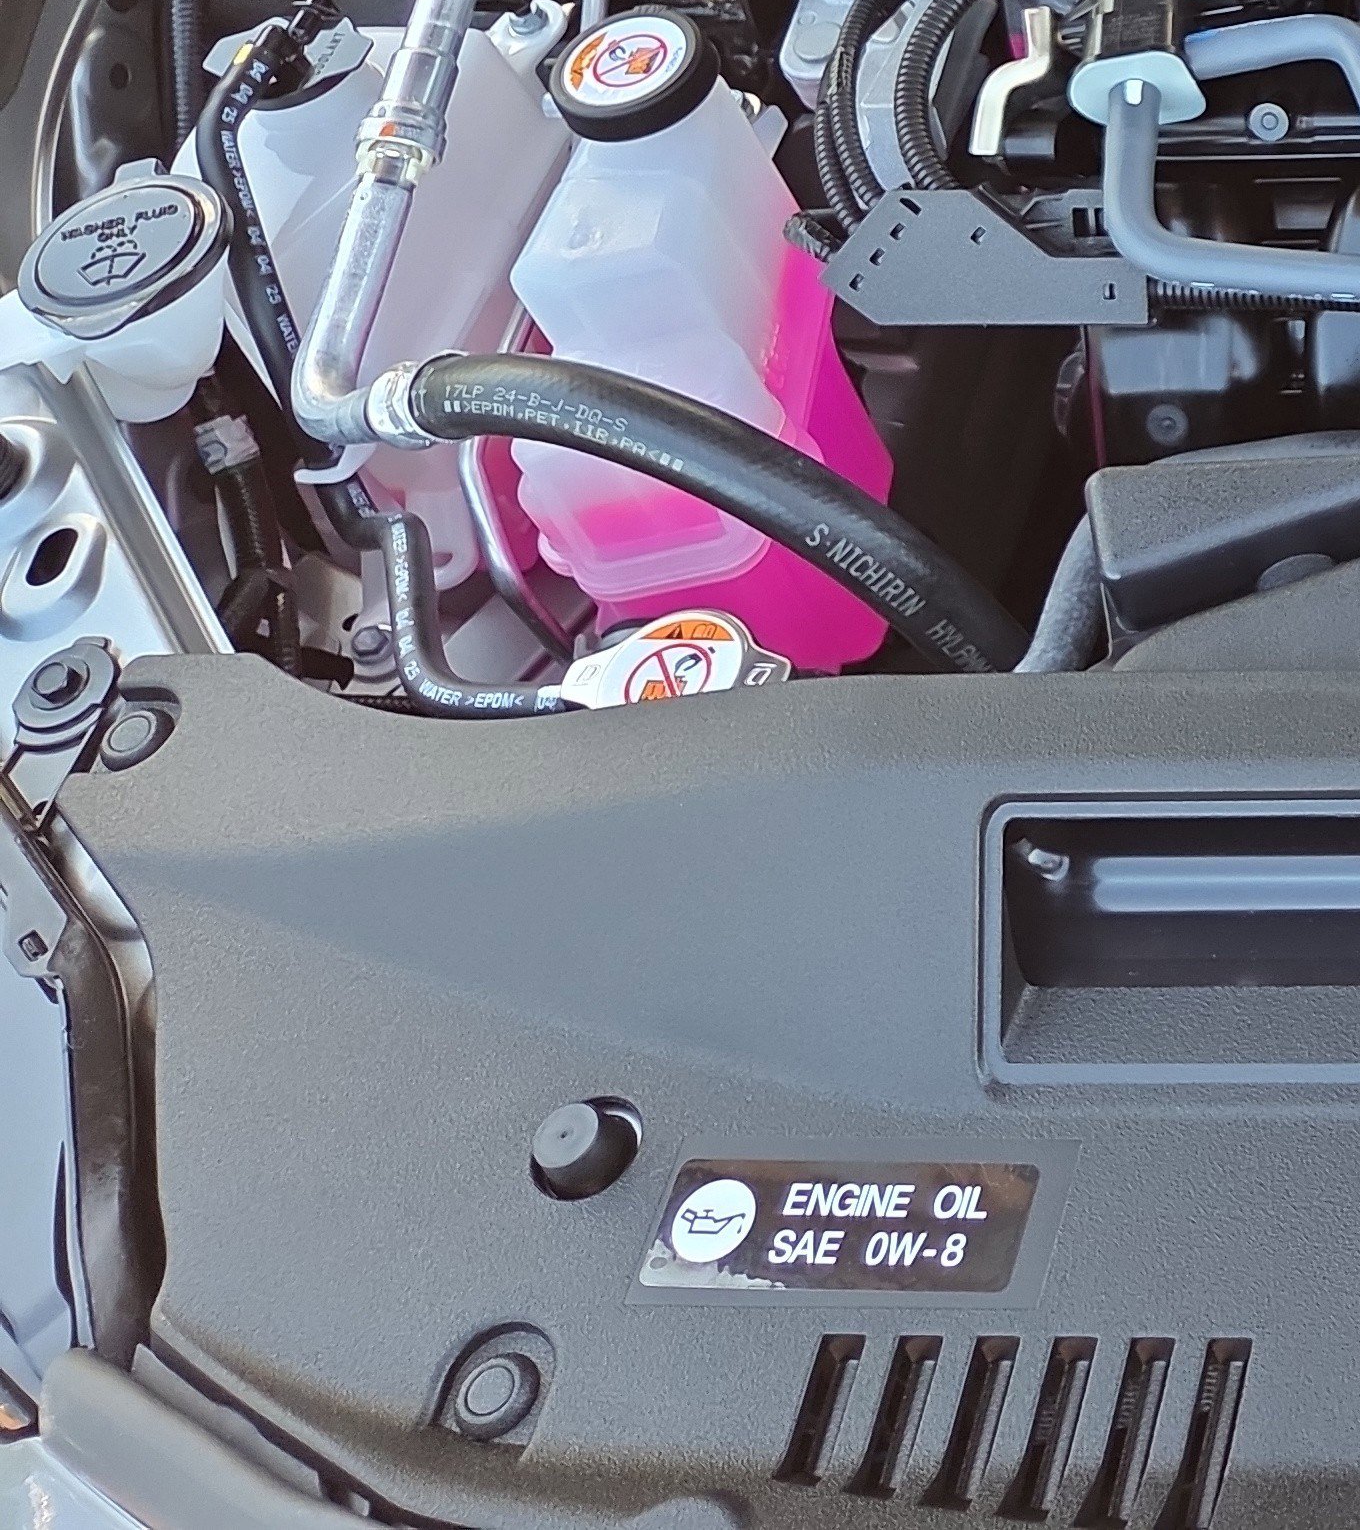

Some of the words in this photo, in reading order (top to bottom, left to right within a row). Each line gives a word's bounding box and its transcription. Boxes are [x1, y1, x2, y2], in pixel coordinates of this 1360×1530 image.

[221, 106, 238, 124] 25
[97, 224, 138, 243] ONLY
[265, 285, 282, 305] 25
[276, 313, 301, 358] WATE
[444, 384, 485, 398] 17LP
[493, 386, 629, 433] 24-B-J-DQ-S
[418, 679, 463, 707] WATER
[464, 691, 525, 709] >EPDM<
[782, 1182, 915, 1219] ENGINE
[932, 1184, 988, 1221] OIL
[767, 1229, 844, 1266] SAE
[864, 1231, 967, 1268] 0W-8
